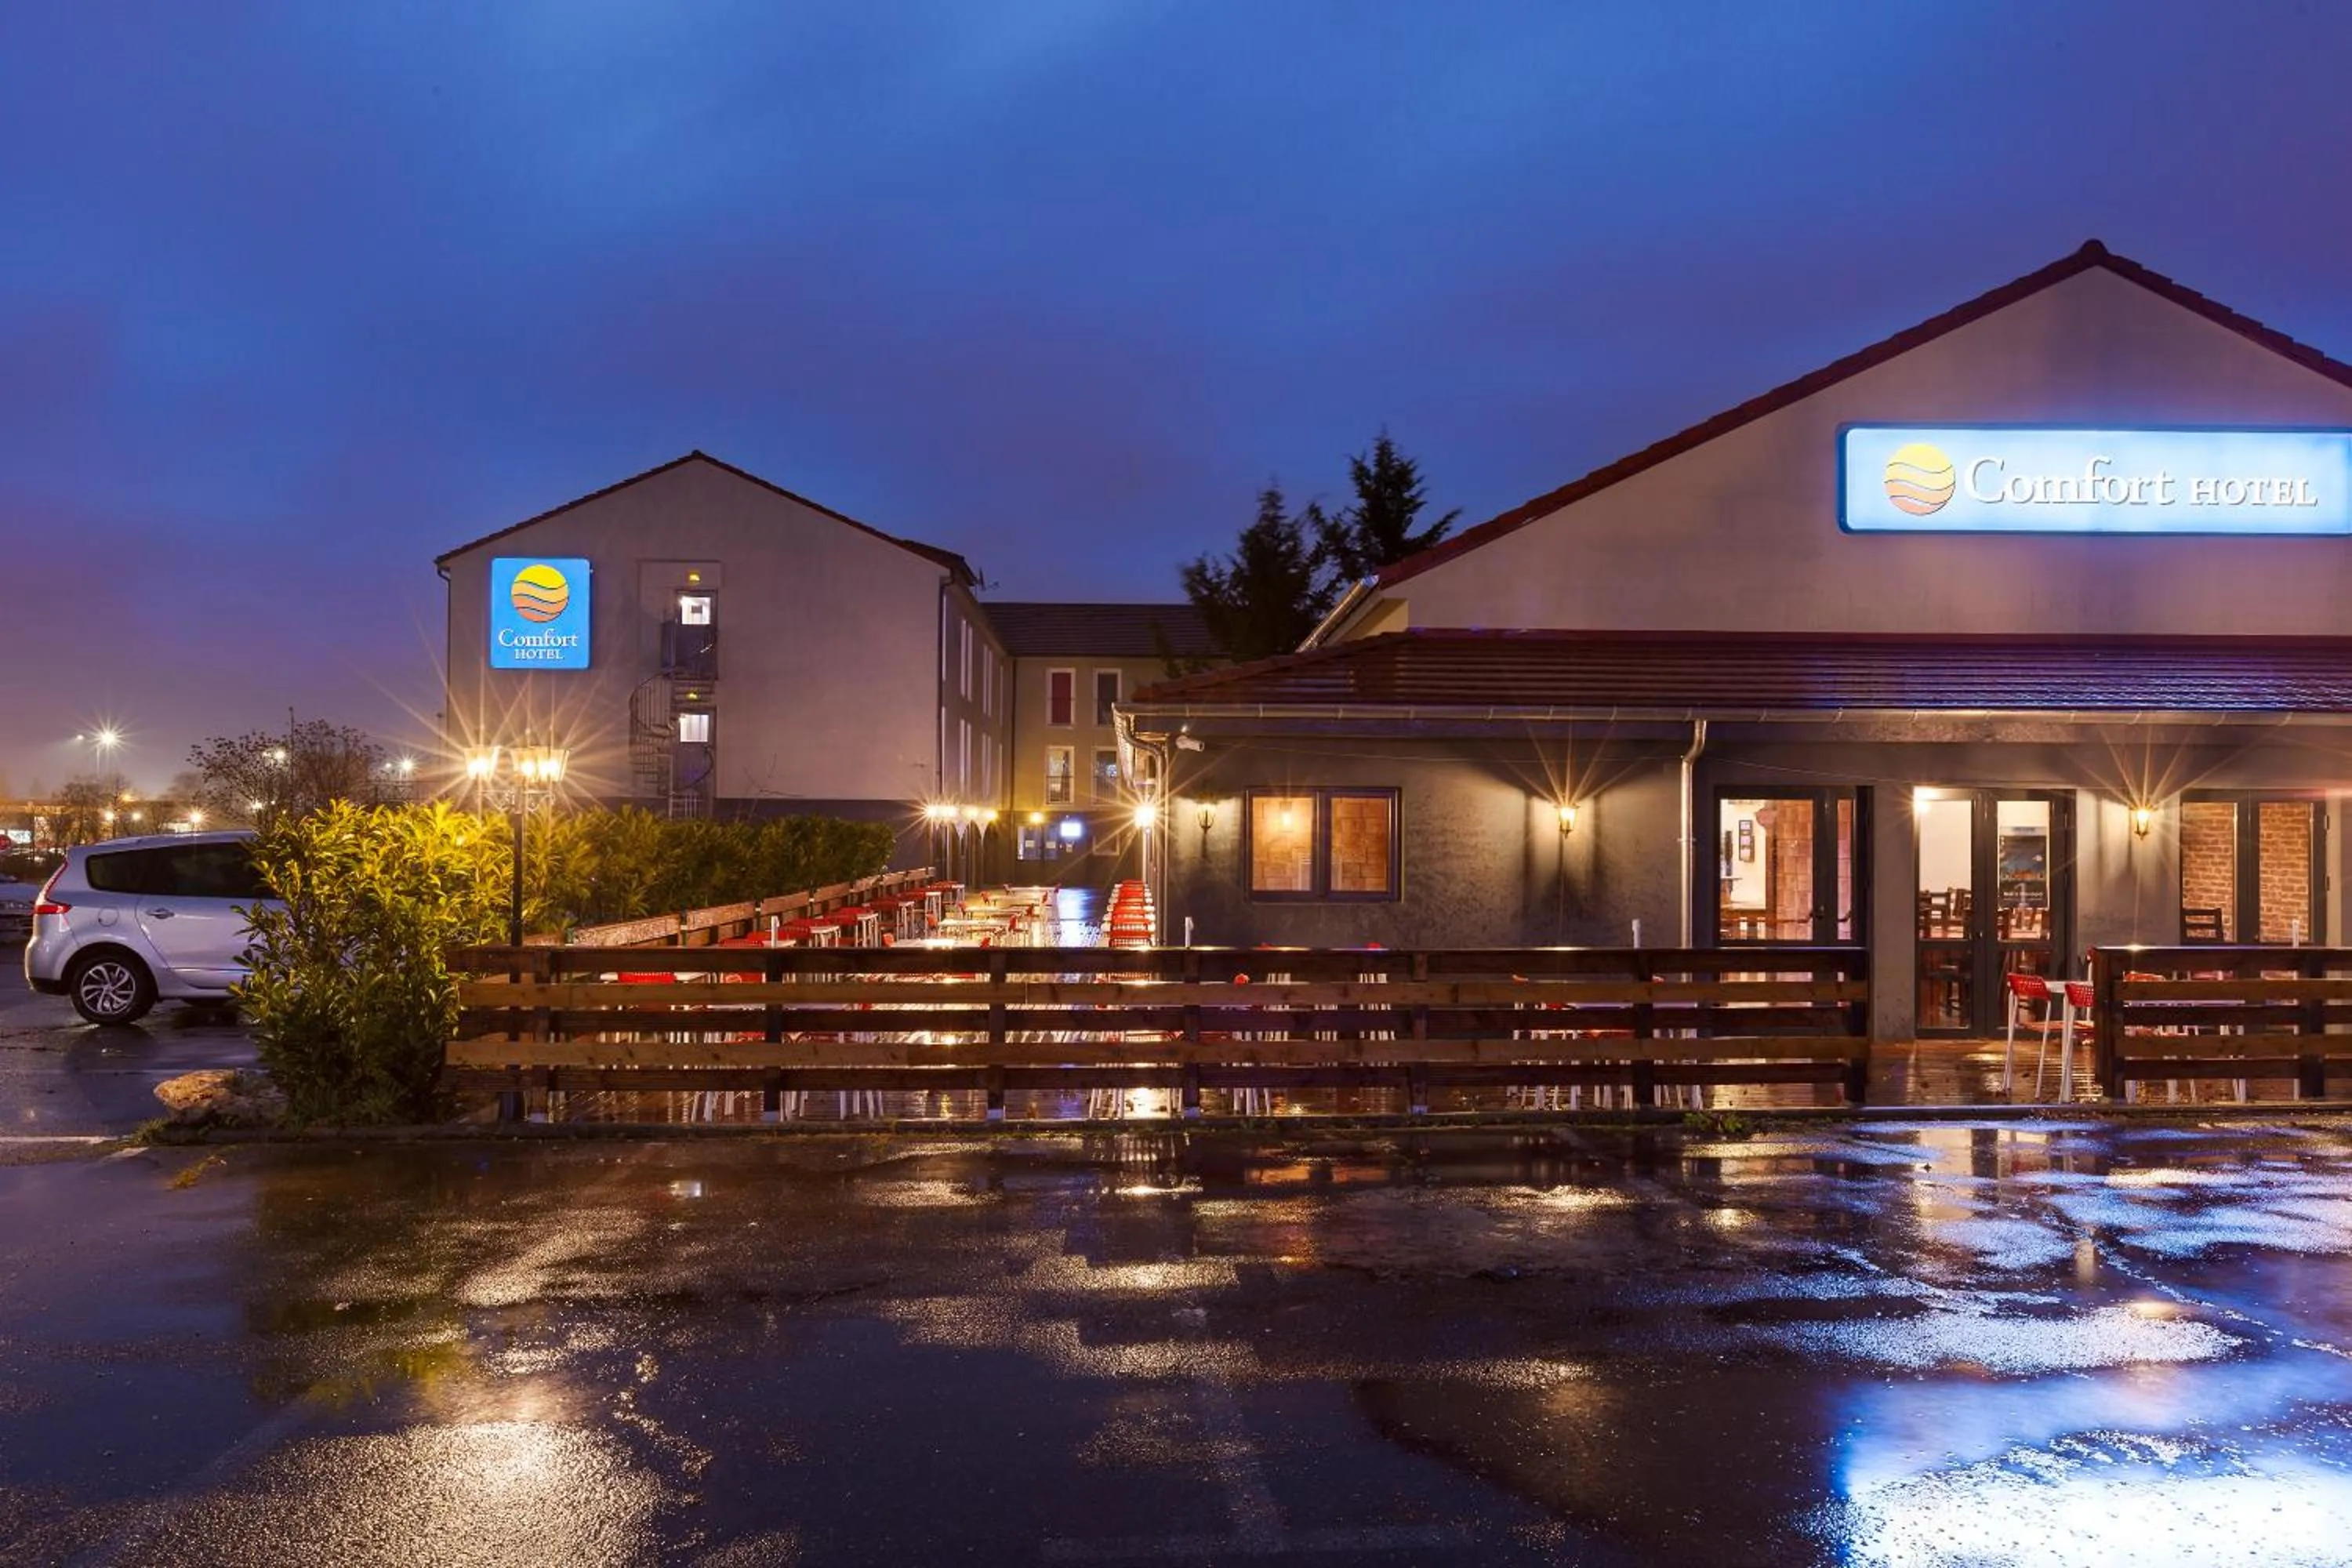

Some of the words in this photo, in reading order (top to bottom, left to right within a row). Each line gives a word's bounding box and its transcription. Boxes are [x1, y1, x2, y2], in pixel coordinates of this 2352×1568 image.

[1964, 456, 2176, 505] Comfort
[2190, 477, 2318, 506] HOTEL
[498, 628, 579, 647] Comfort
[514, 648, 564, 659] HOTEL
